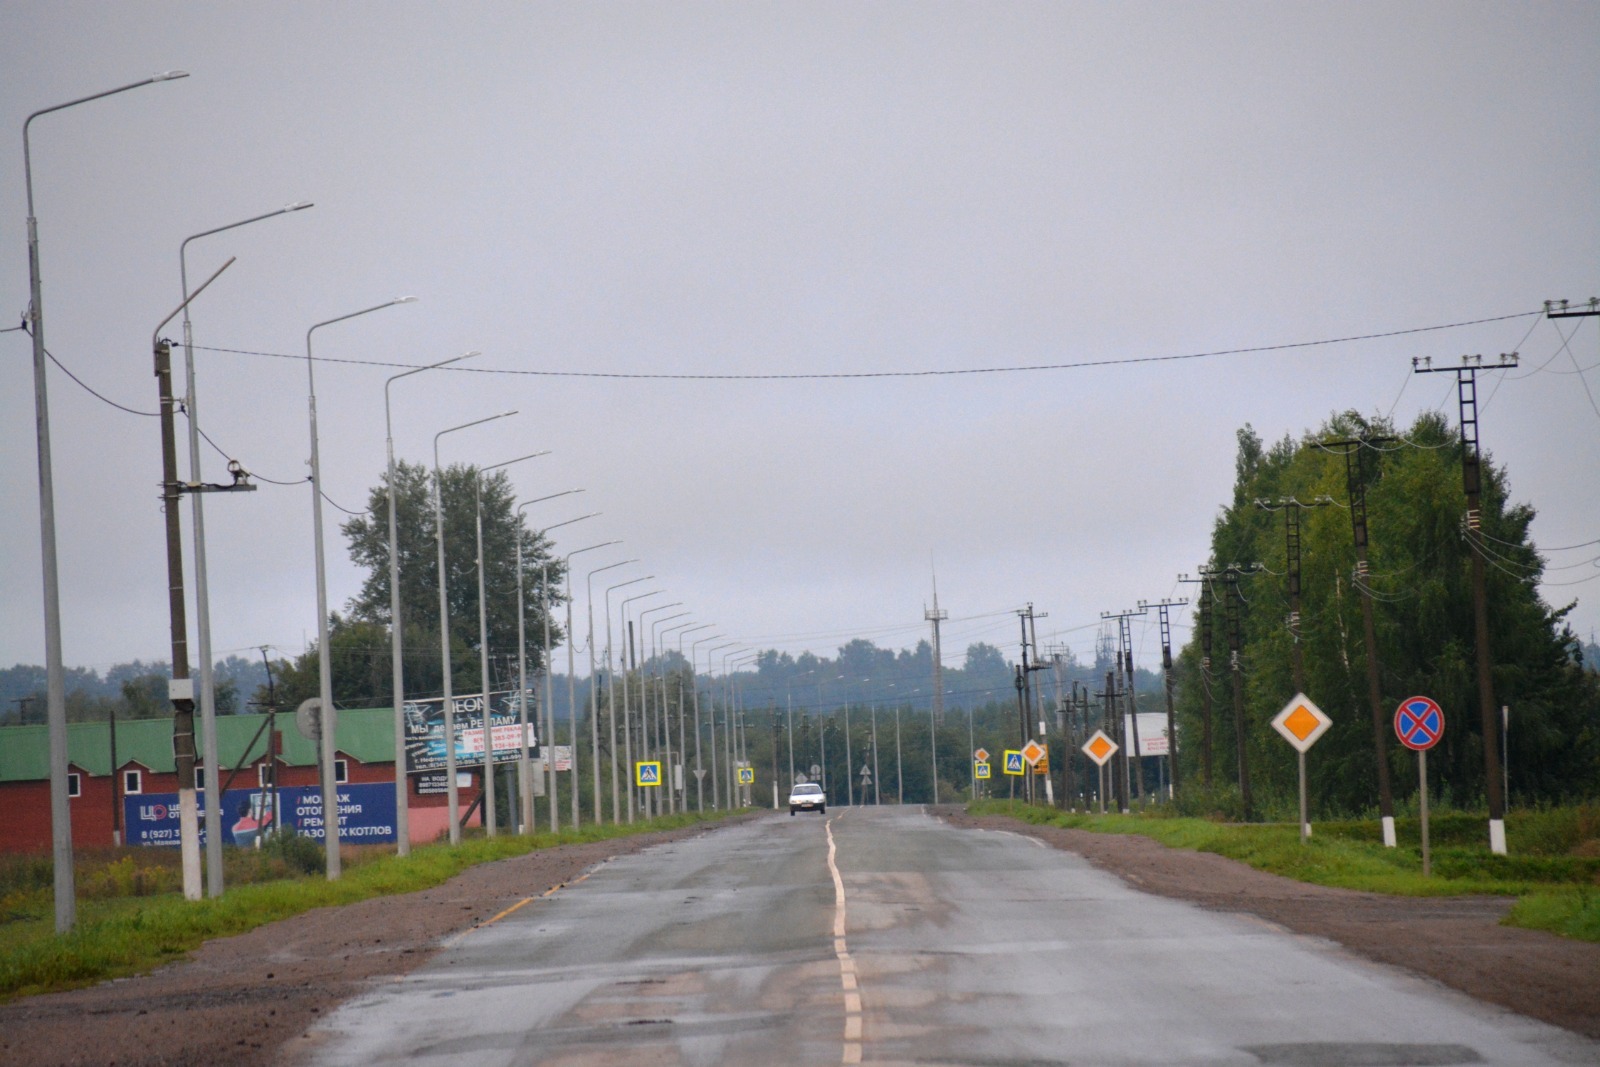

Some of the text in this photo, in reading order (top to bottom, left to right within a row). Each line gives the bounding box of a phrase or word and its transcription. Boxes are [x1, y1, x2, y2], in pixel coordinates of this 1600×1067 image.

[434, 723, 469, 733] деем
[471, 715, 516, 728] РЕЛАМУ
[464, 728, 502, 737] РАЗМЕНИЕ
[303, 794, 350, 804] МОАЖ
[296, 805, 362, 815] ОТОЕНИЯ
[303, 816, 348, 827] РЕМНТ
[149, 829, 172, 839] (927)
[297, 826, 392, 838] ГАЗОХ КОТЛОВ
